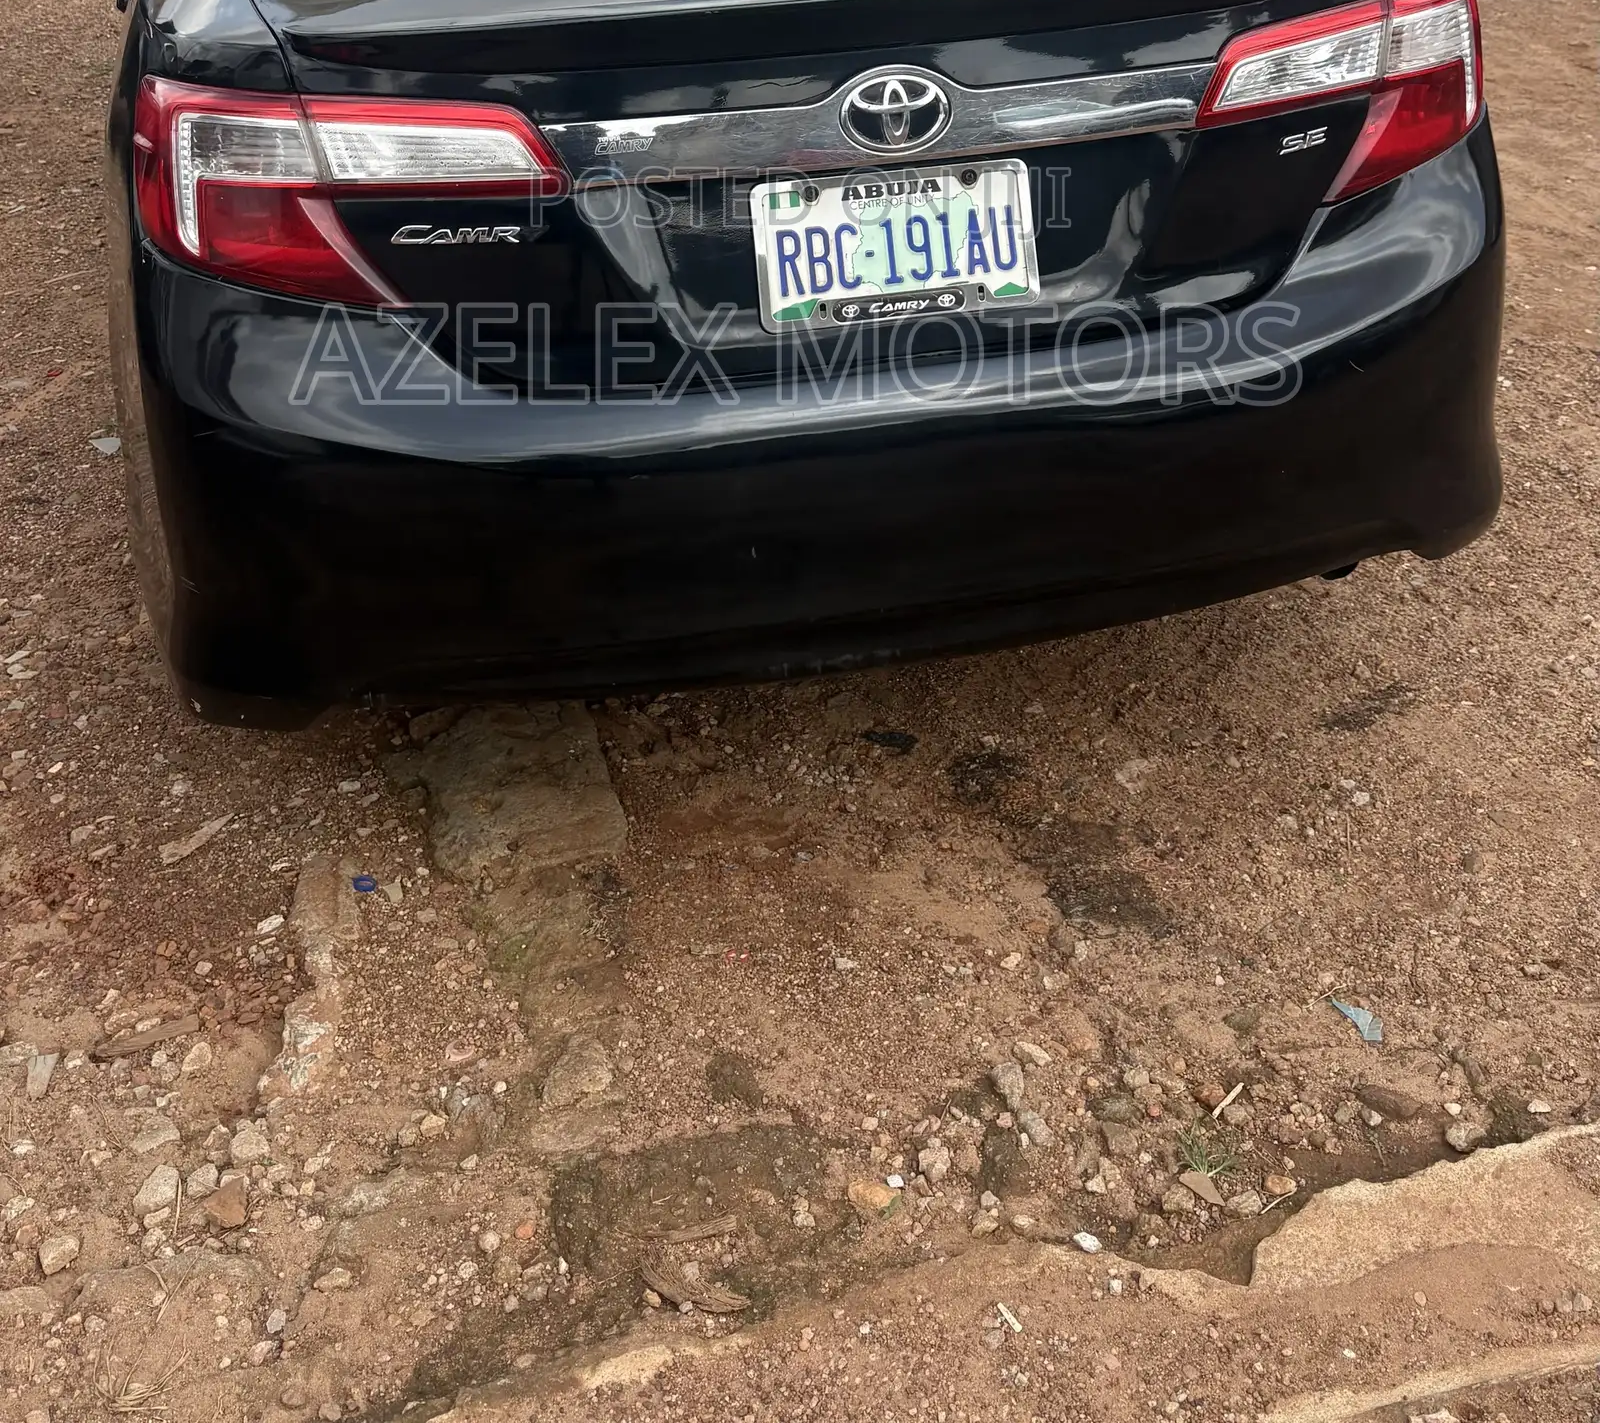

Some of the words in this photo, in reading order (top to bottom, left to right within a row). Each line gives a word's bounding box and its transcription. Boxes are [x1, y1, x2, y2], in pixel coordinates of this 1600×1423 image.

[594, 137, 654, 156] CAMRY
[1278, 126, 1328, 156] SE
[841, 178, 942, 201] ABUJA
[849, 197, 887, 210] CENTRE
[868, 299, 930, 313] CAMRY
